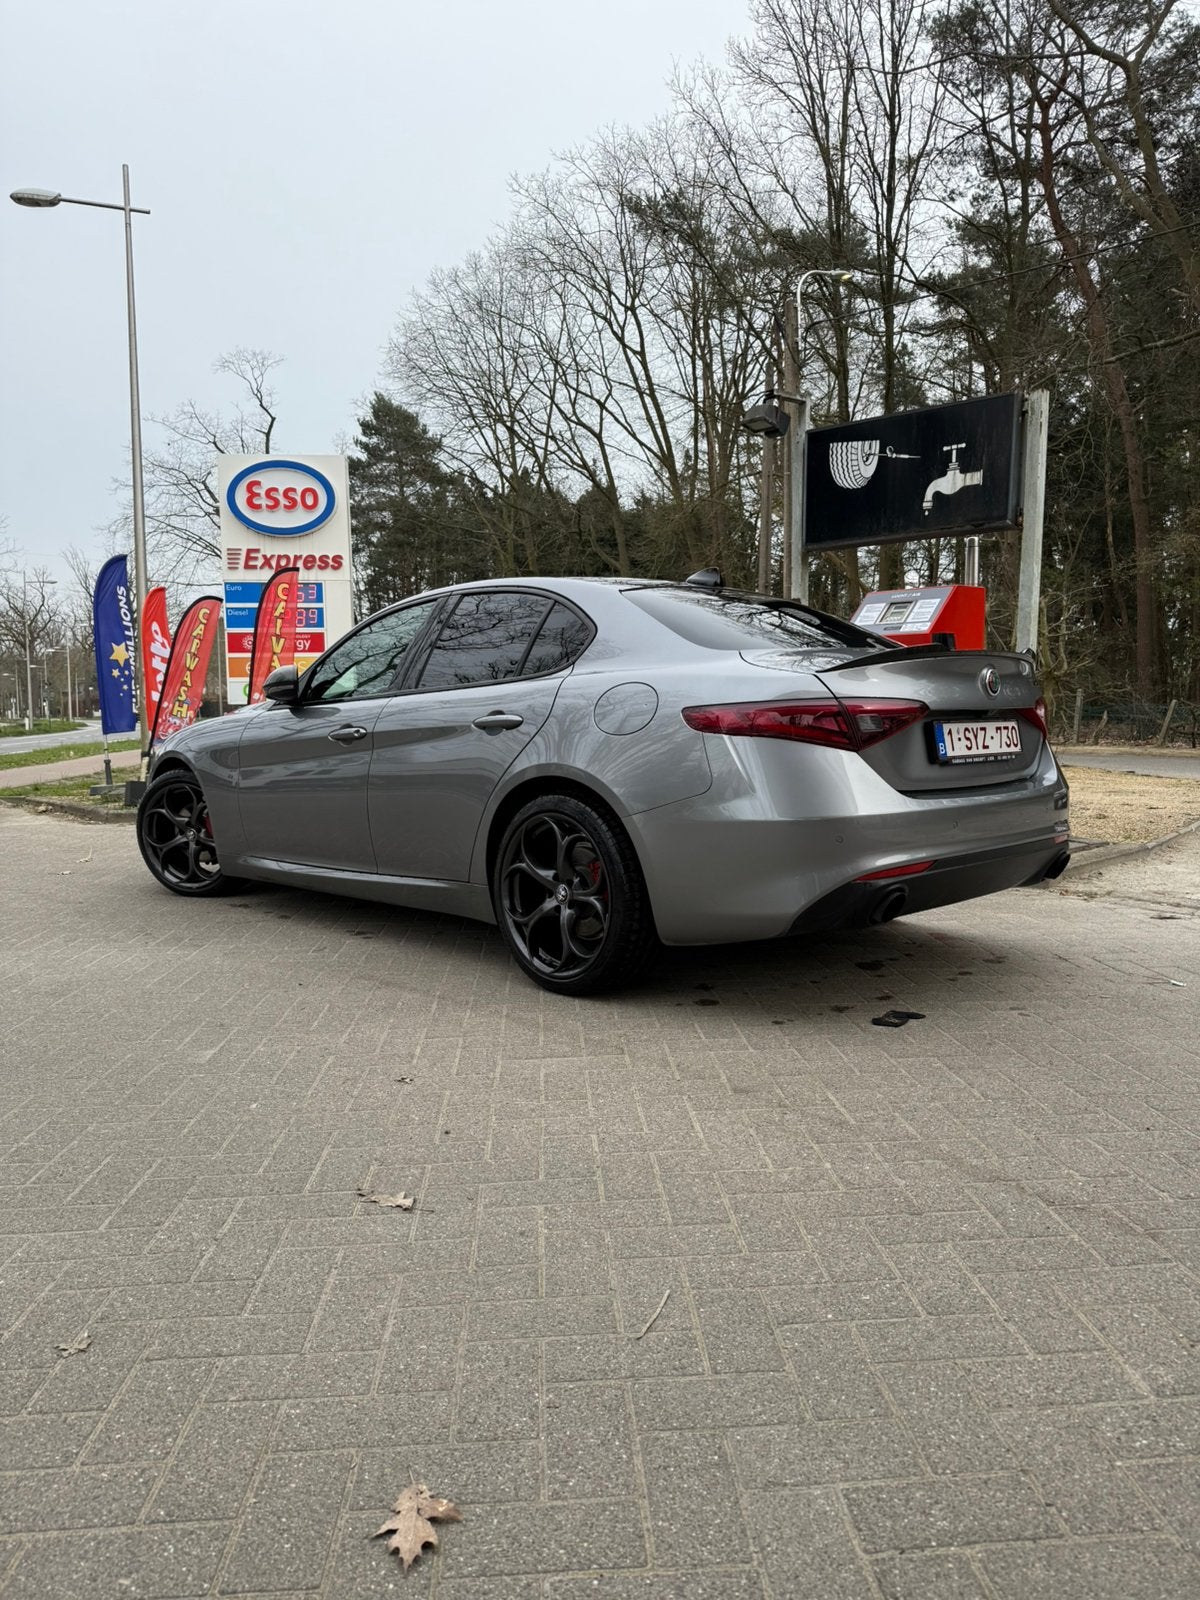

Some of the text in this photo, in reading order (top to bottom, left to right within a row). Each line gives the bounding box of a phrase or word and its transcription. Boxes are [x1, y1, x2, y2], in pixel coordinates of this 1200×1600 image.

[243, 548, 343, 573] Express
[227, 608, 248, 616] Diesel
[939, 743, 946, 754] B
